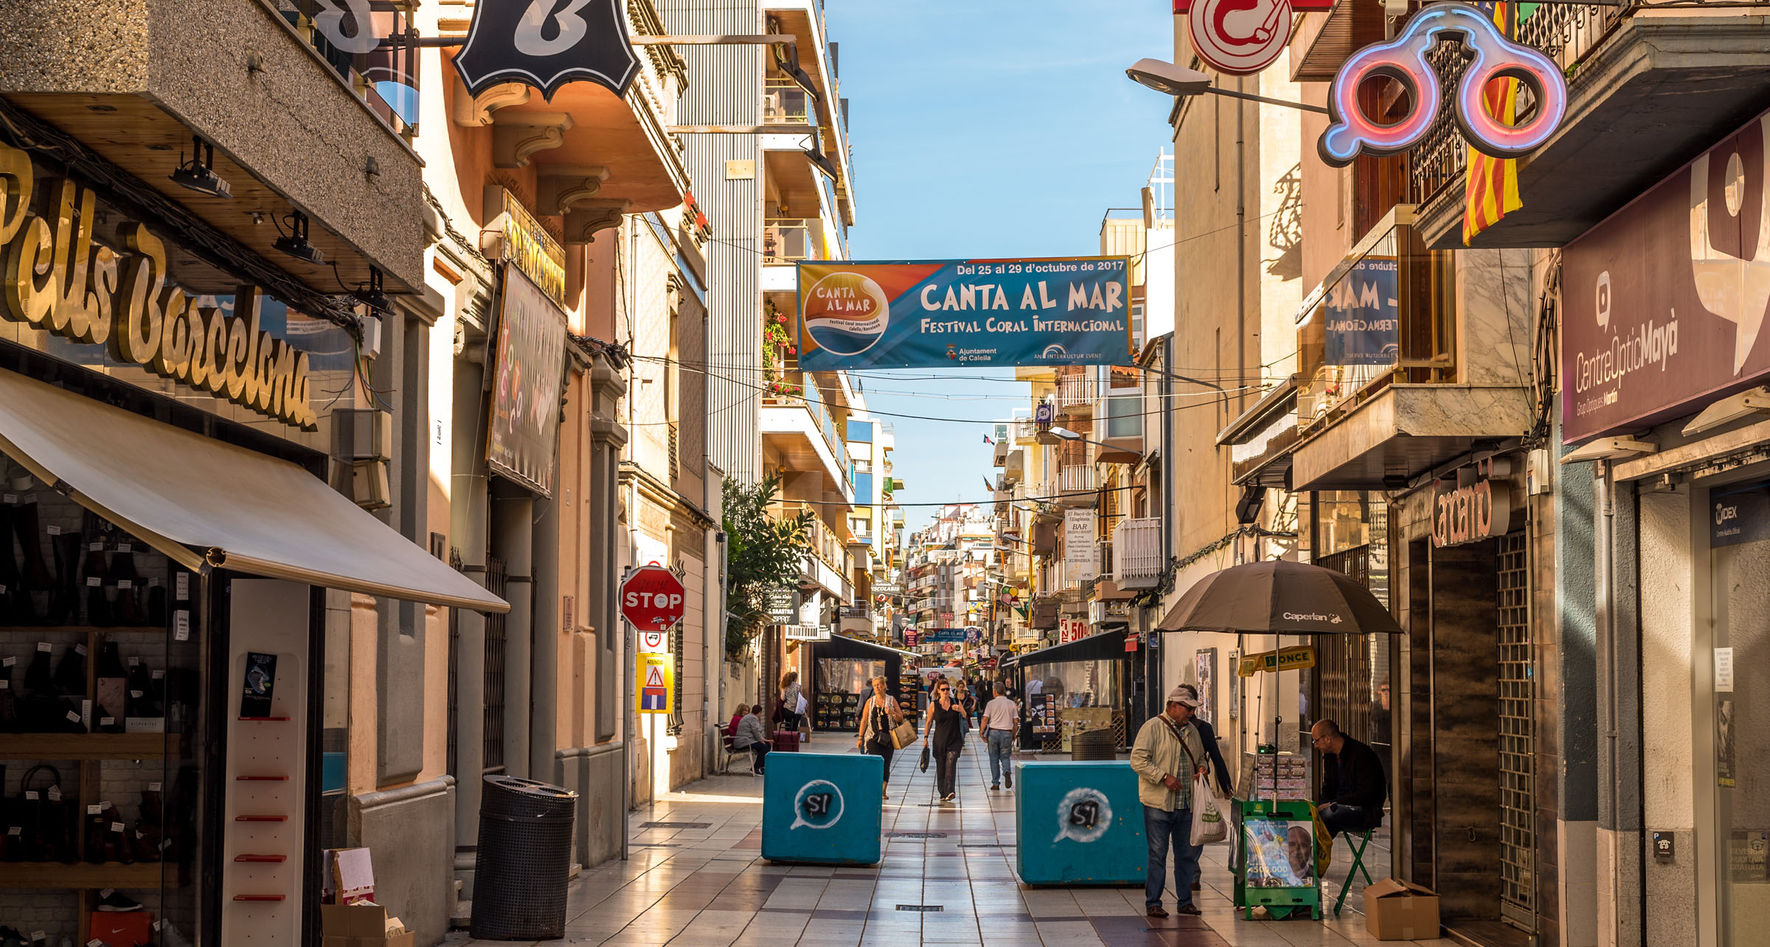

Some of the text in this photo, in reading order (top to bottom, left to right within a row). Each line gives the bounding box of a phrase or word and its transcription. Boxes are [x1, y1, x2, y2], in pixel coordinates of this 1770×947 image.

[957, 261, 1124, 275] Del 25 al 29 d'octubre de 2017
[816, 287, 855, 299] CANTA
[920, 281, 1123, 313] CANTA AL MAR
[826, 299, 871, 312] AL MAR
[118, 222, 318, 431] Barcelona
[985, 317, 1028, 334] CORAL
[625, 591, 682, 609] STOP
[1283, 611, 1327, 622] Caperlan
[1279, 652, 1308, 664] ONCE
